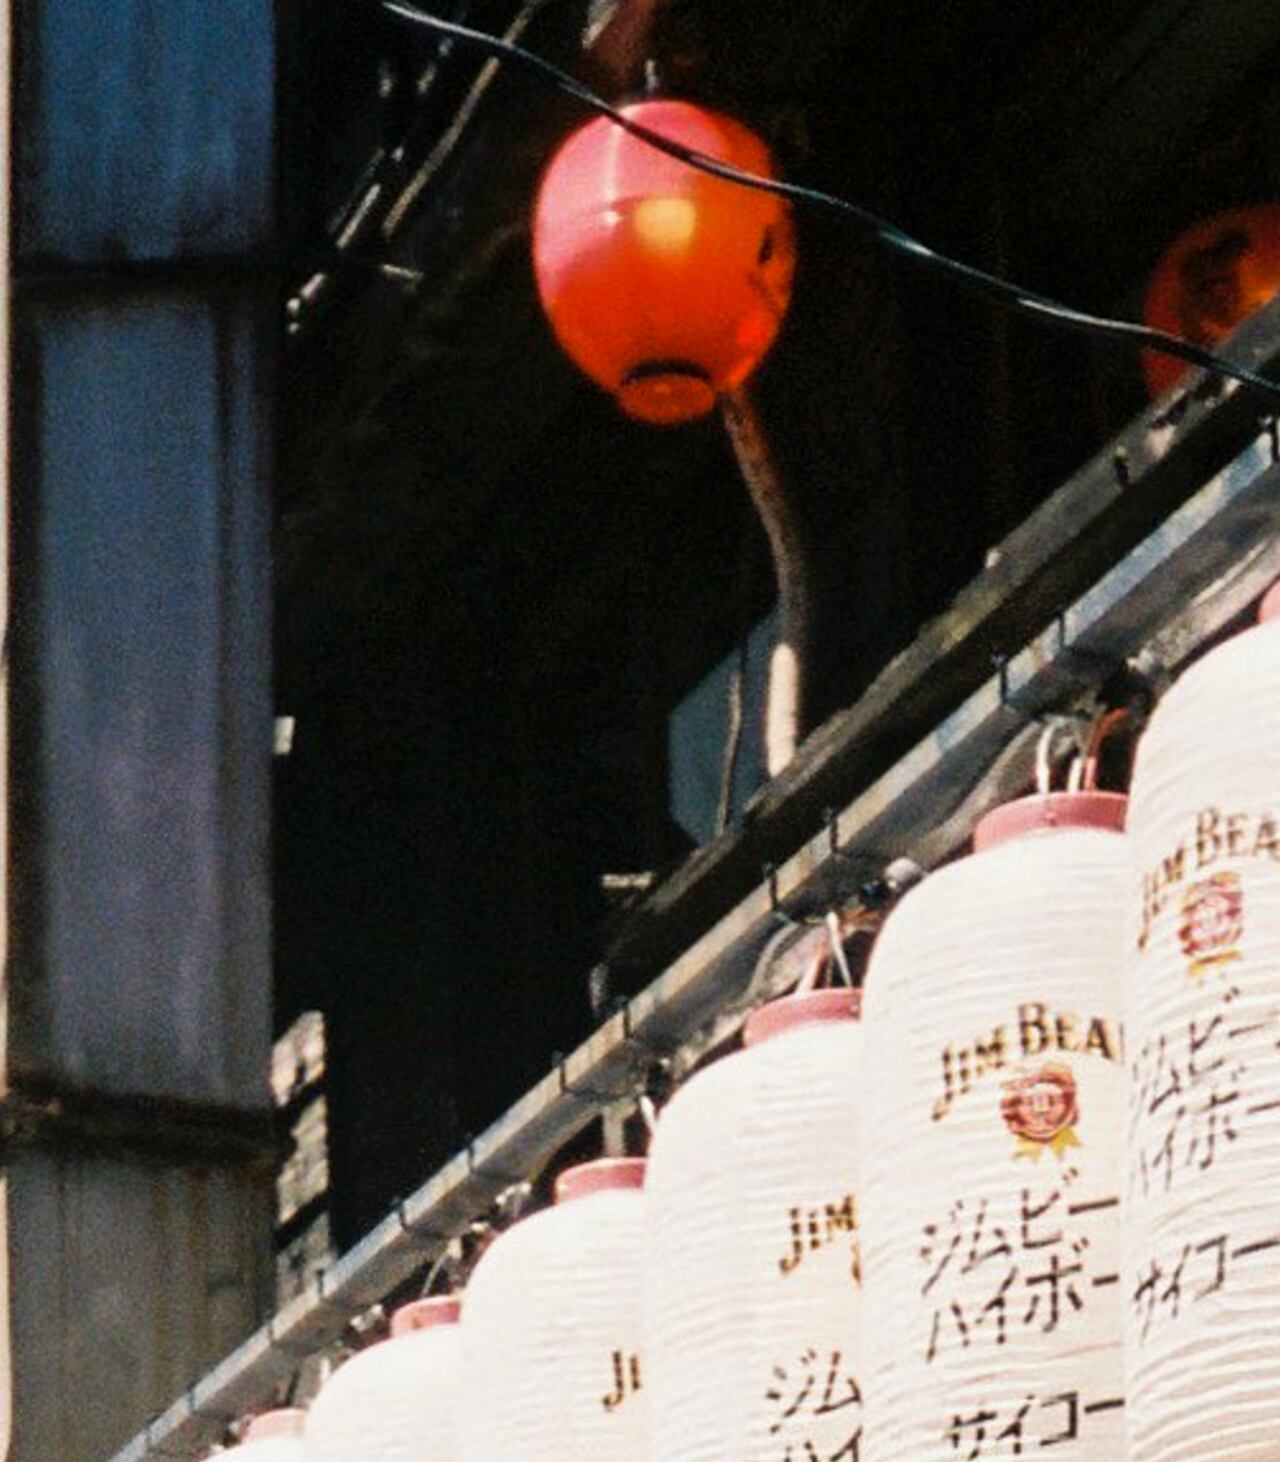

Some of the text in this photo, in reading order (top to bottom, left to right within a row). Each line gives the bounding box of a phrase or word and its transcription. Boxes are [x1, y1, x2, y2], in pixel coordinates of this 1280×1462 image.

[932, 998, 1123, 1120] JIM BEA
[779, 1194, 858, 1274] JIM
[766, 1348, 864, 1434] ジム
